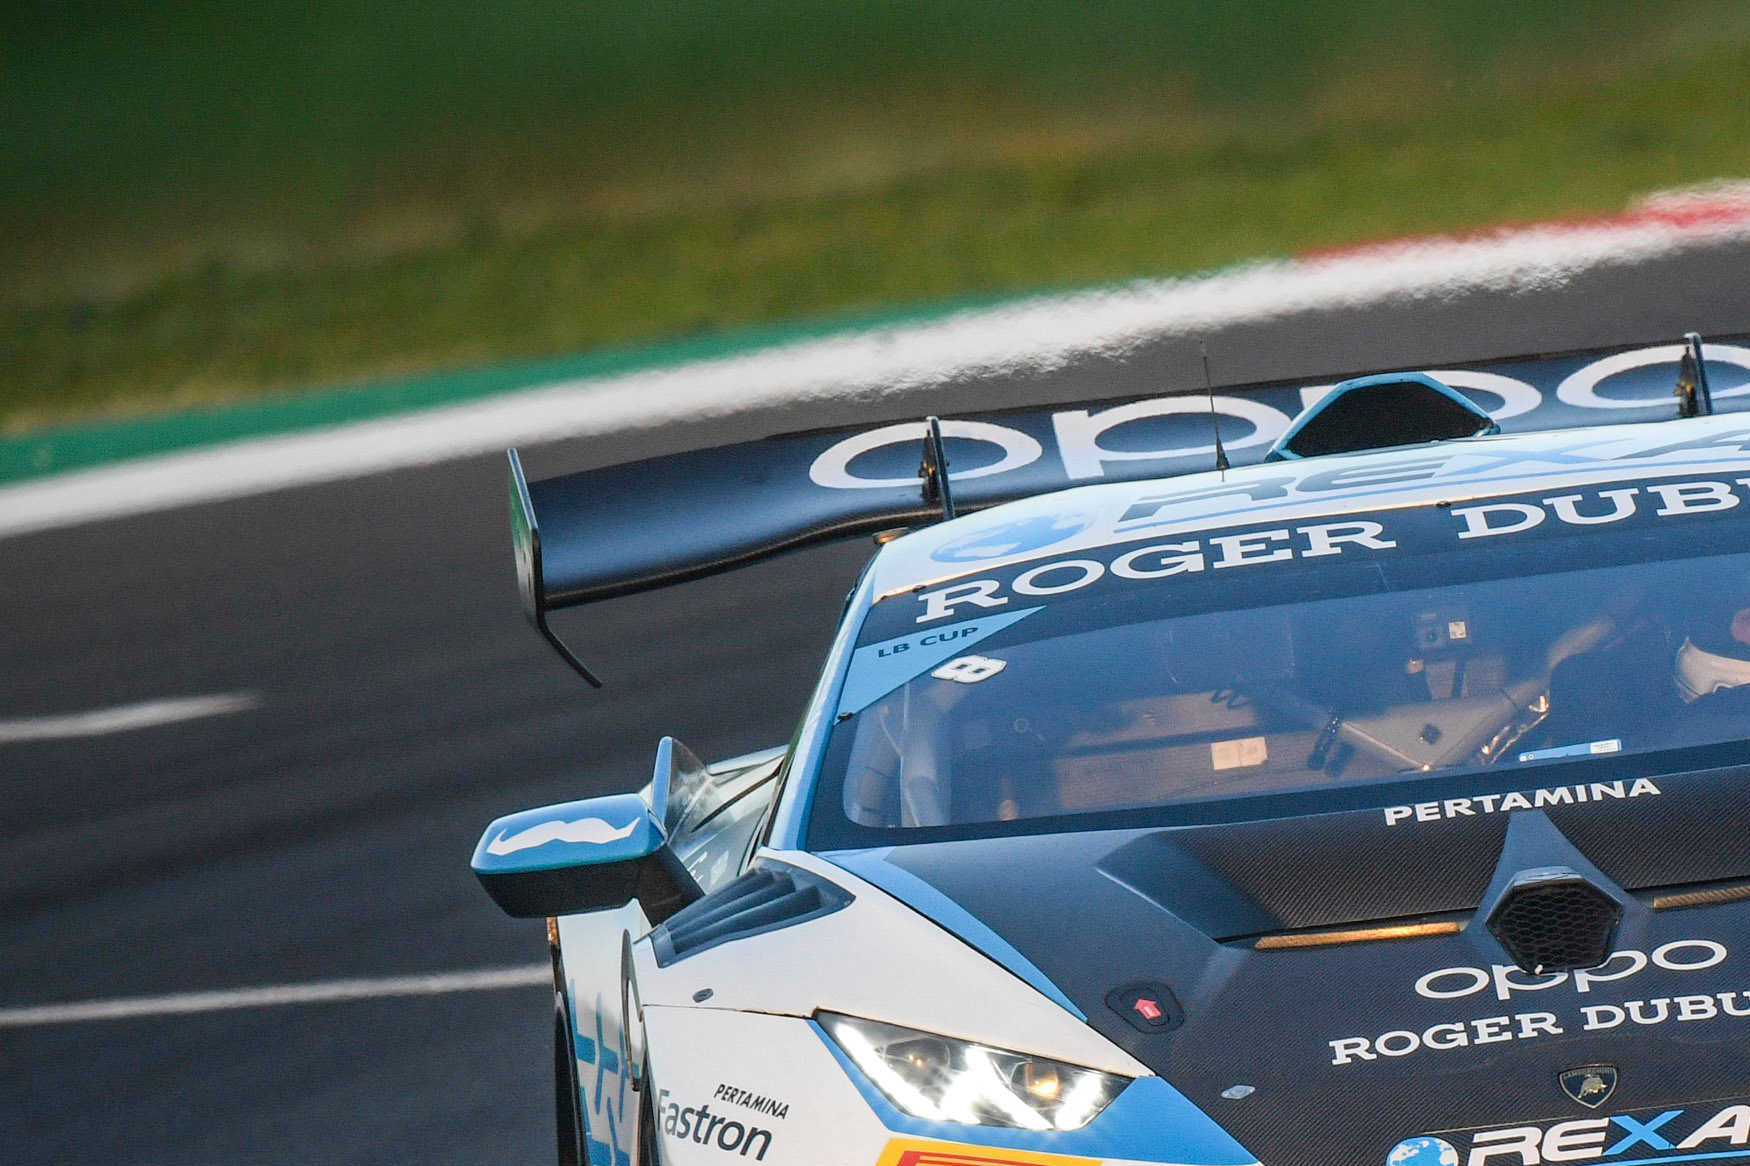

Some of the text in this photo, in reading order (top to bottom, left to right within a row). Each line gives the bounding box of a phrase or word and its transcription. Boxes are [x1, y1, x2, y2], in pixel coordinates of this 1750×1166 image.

[915, 520, 1397, 624] ROGER
[878, 627, 978, 658] LB CUP
[1384, 777, 1662, 826] PERTAMINA
[1415, 940, 1728, 1000] oppo
[1329, 1011, 1563, 1066] ROGER
[657, 1088, 773, 1161] Fastron
[713, 1083, 790, 1120] PERTAMINA
